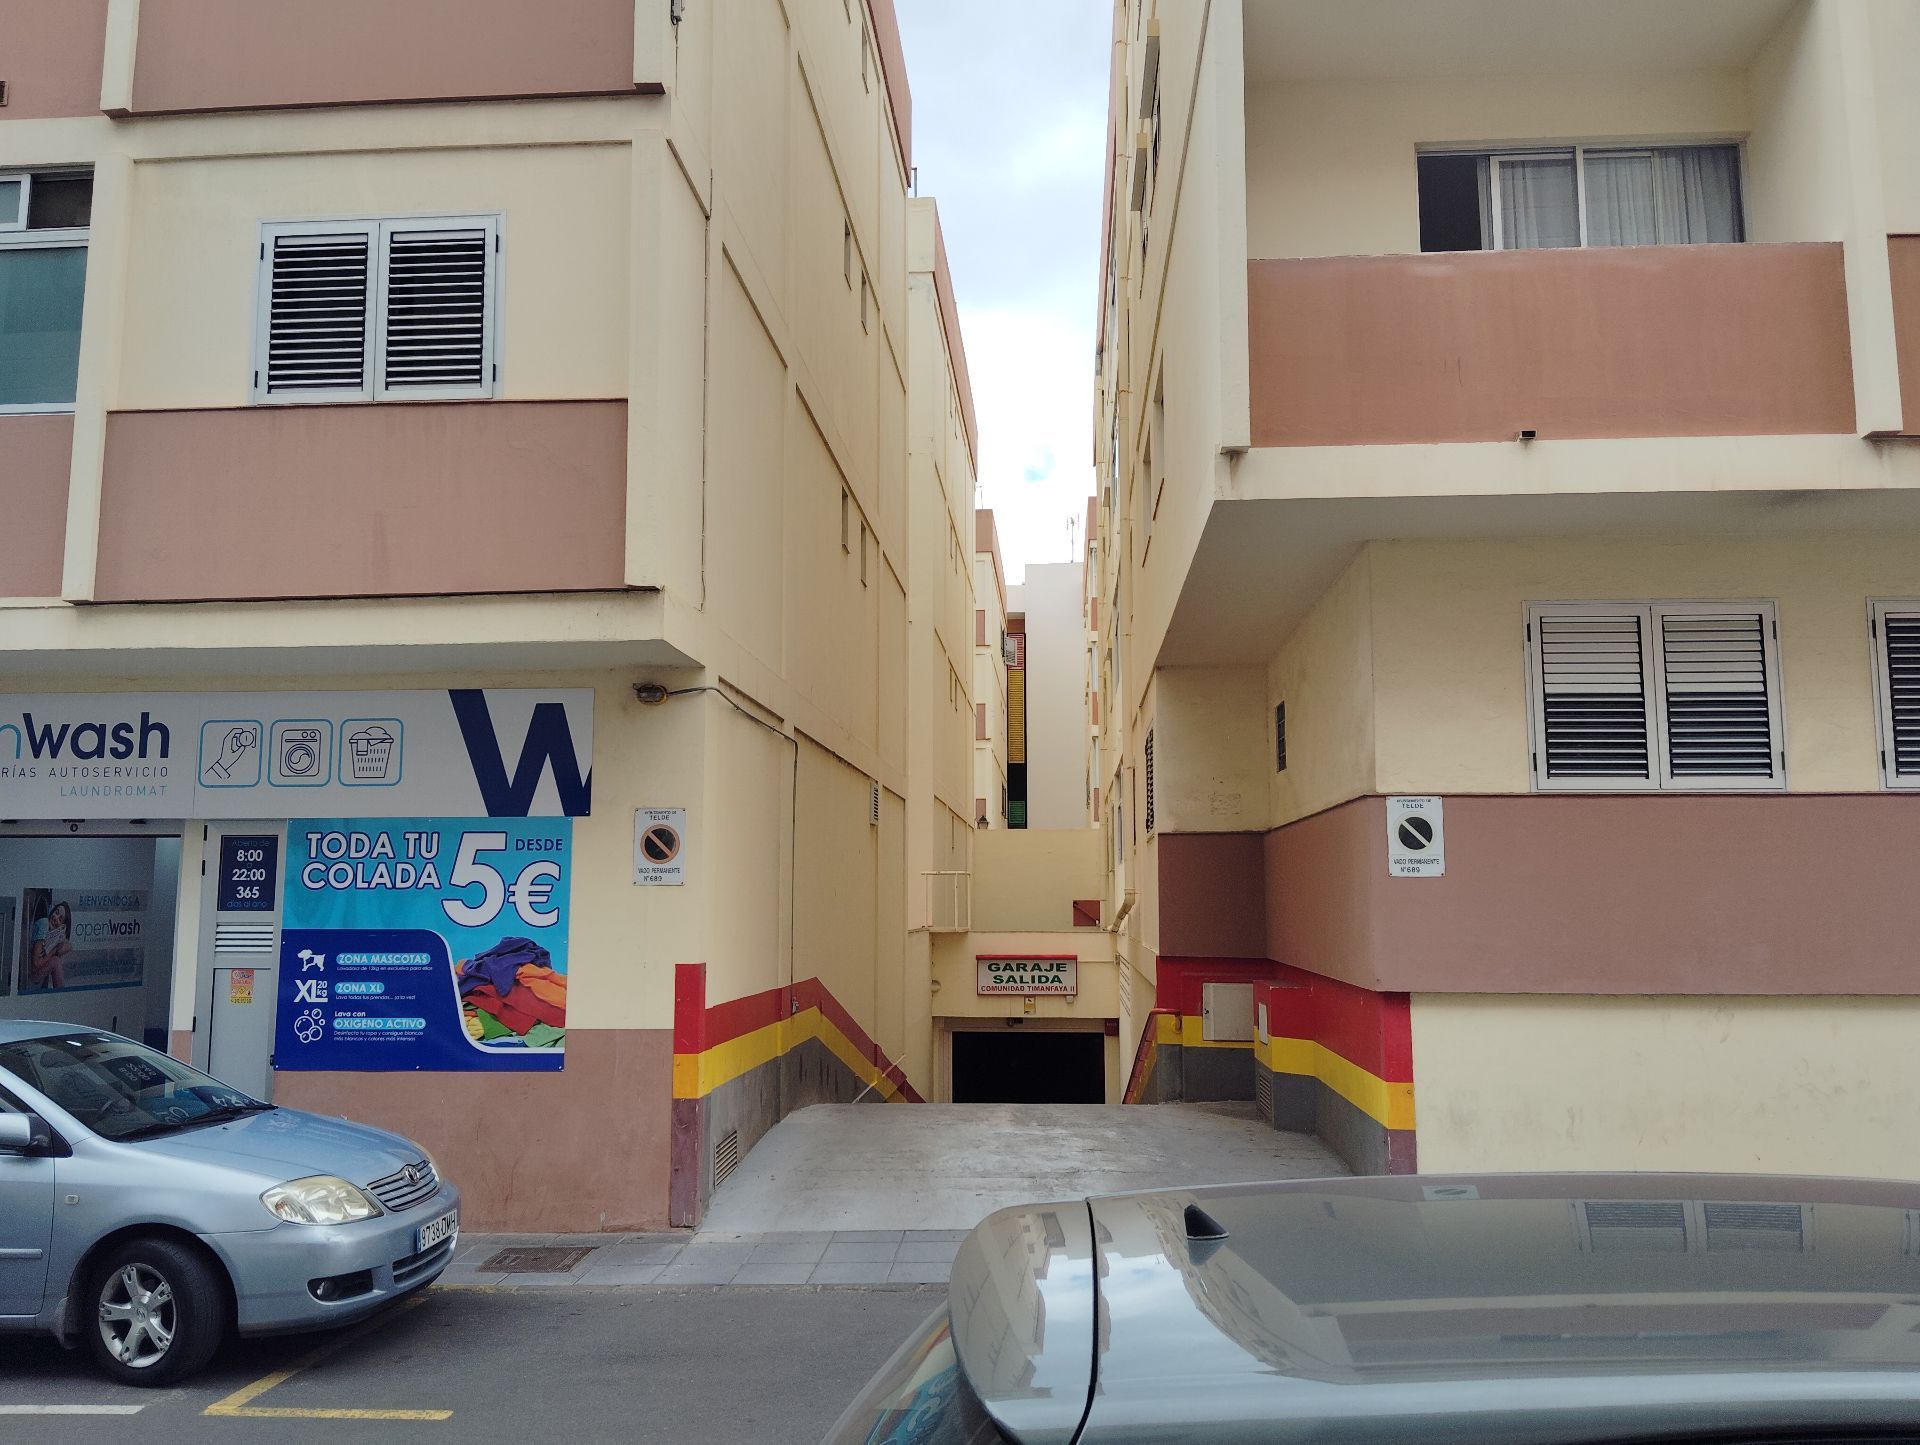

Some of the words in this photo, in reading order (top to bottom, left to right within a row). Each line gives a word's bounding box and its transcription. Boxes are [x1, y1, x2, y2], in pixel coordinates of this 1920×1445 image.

[48, 766, 169, 778] AUTOSERVICIO
[60, 785, 169, 797] LAUNDROMAT
[306, 831, 396, 859] TODA
[404, 831, 441, 859] TU
[515, 838, 564, 851] DESDE
[237, 849, 263, 862] 8:00
[232, 869, 266, 881] 22:00
[302, 862, 442, 890] COLADA
[236, 886, 260, 899] 365
[339, 954, 369, 964] ZONA
[371, 954, 427, 964] MASCOTAS
[987, 963, 1068, 972] GARAJE
[992, 975, 1063, 984] SALIDA
[294, 980, 328, 1002] XL
[317, 988, 328, 997] kg
[337, 984, 366, 993] ZONA
[370, 984, 381, 993] XL
[386, 1019, 426, 1029] ACTIVO
